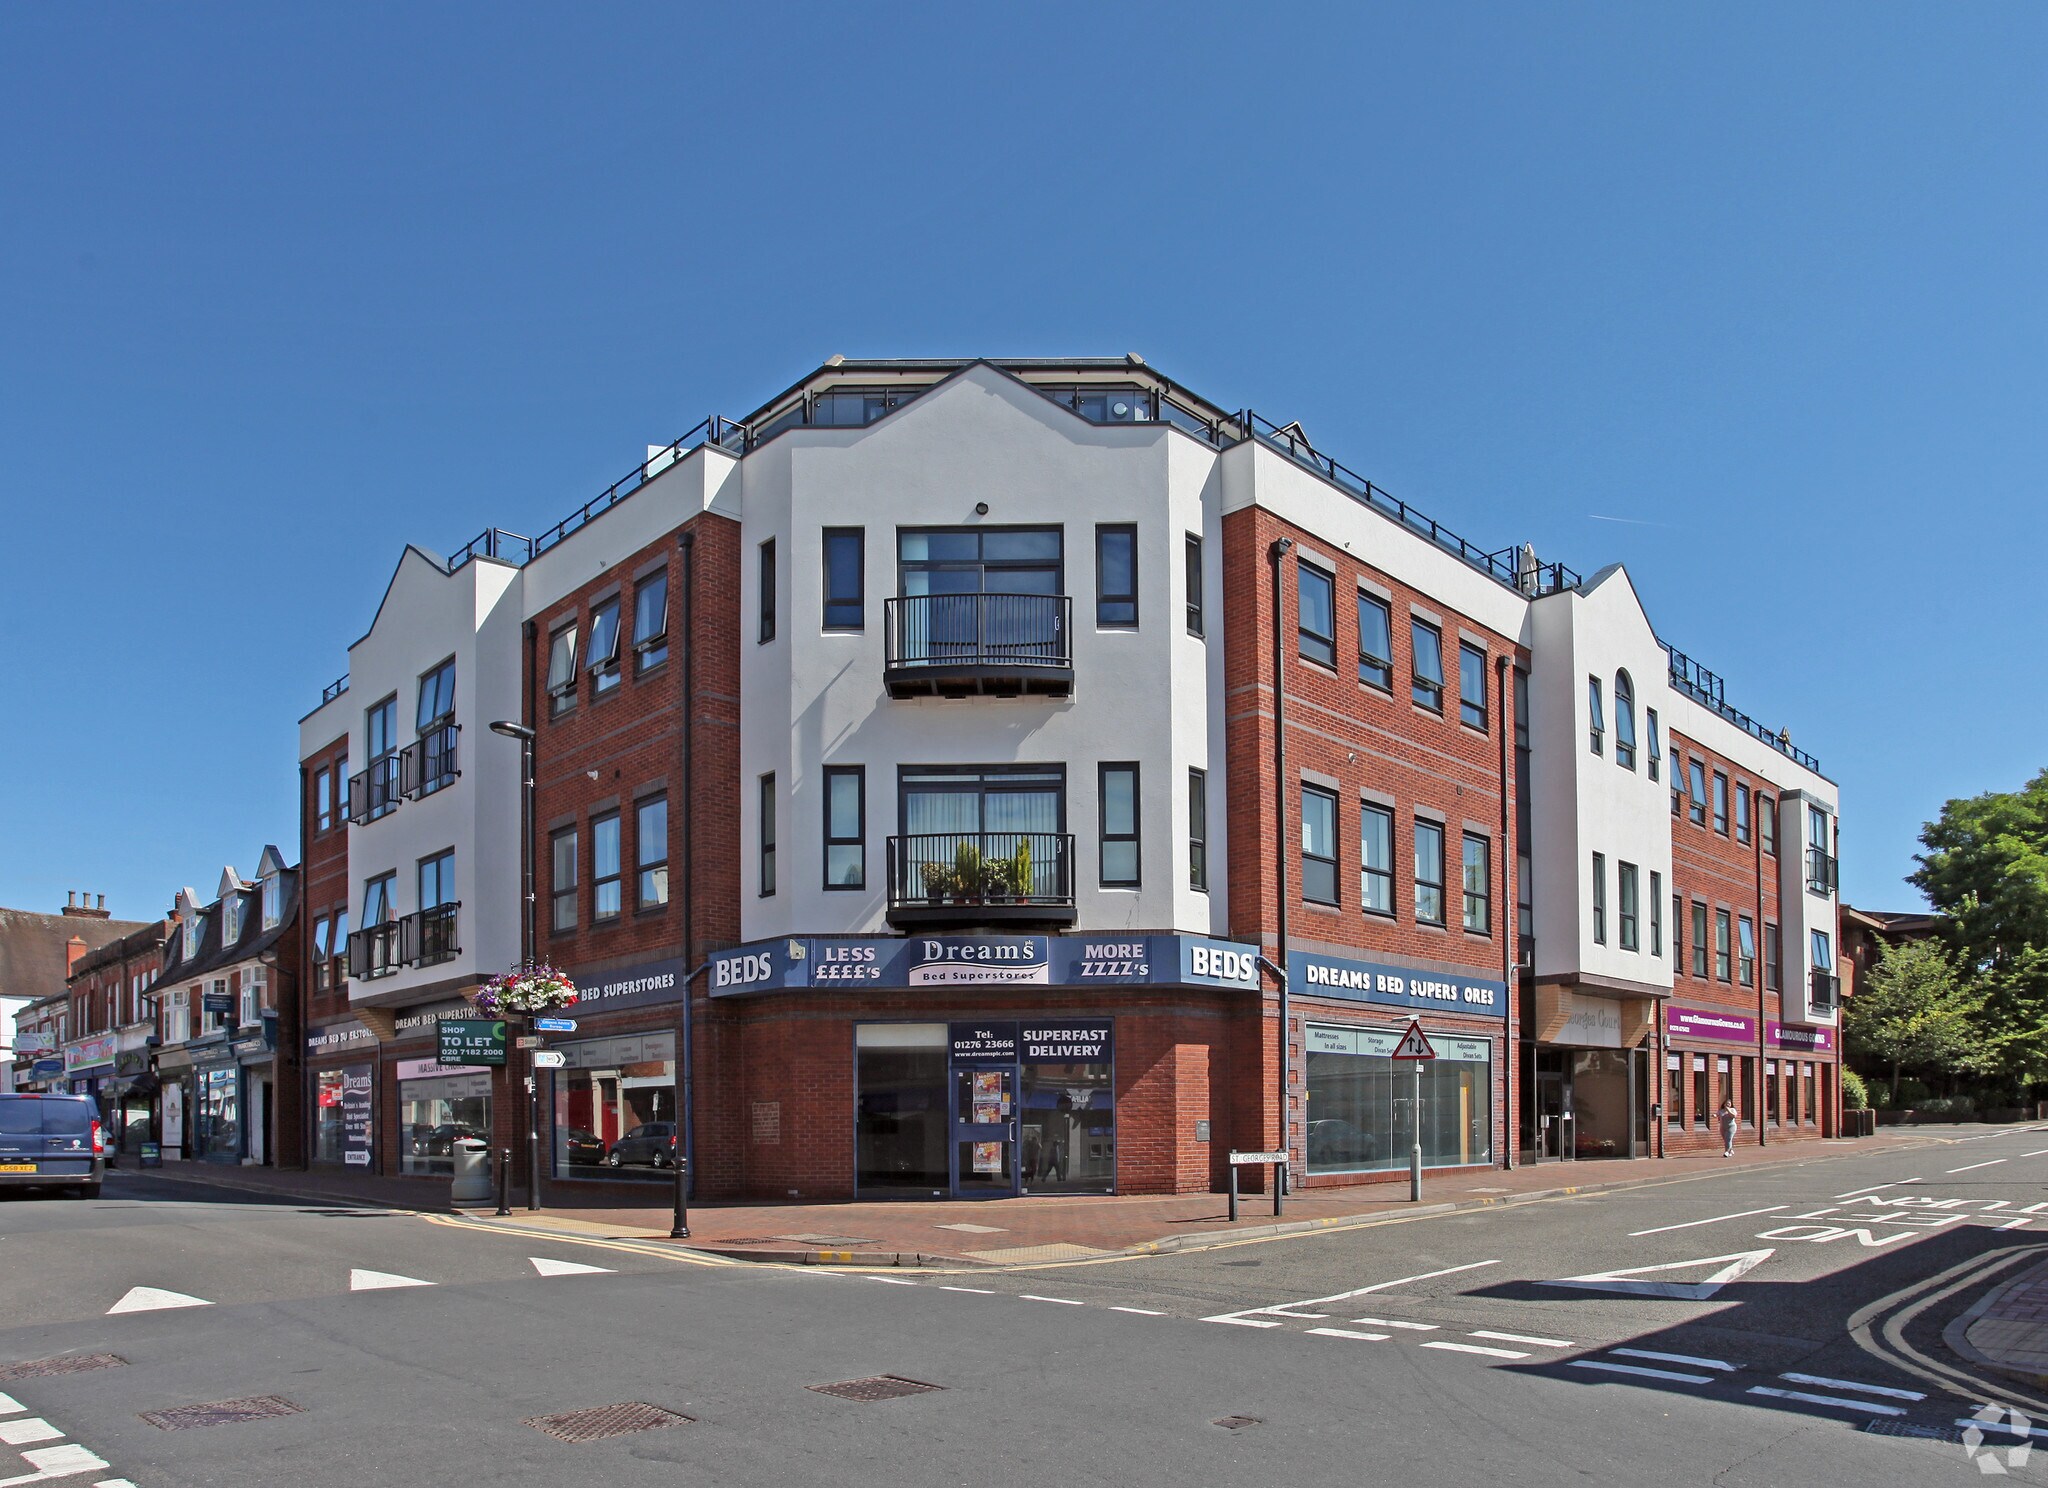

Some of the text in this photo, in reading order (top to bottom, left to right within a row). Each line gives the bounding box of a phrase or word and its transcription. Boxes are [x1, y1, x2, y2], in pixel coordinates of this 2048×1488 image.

[825, 947, 875, 962] LESS
[923, 941, 1035, 960] Dreams
[1085, 944, 1144, 959] MORE
[716, 952, 772, 987] BEDS
[1081, 961, 1149, 976] ZZZZ's
[1192, 946, 1253, 981] BEDS
[953, 972, 1034, 981] Superstores
[1307, 965, 1371, 990] DREAMS
[1376, 975, 1404, 994] BED
[581, 973, 675, 1001] BED SUPERSTORES
[395, 1016, 421, 1030] DREAMS
[422, 1014, 436, 1025] BED
[329, 1034, 339, 1044] BED
[975, 1031, 993, 1039] Tel:
[1023, 1030, 1108, 1041] SUPERFAST
[1314, 1031, 1339, 1040] Mattresses
[1368, 1037, 1384, 1045] Storage
[442, 1037, 492, 1046] TO LET
[955, 1040, 1014, 1049] 01276 23666
[1457, 1042, 1476, 1050] Adjustable
[1029, 1045, 1101, 1057] DELIVERY
[344, 1074, 372, 1088] Dreams
[1231, 1153, 1288, 1163] ST GEORGES ROAD
